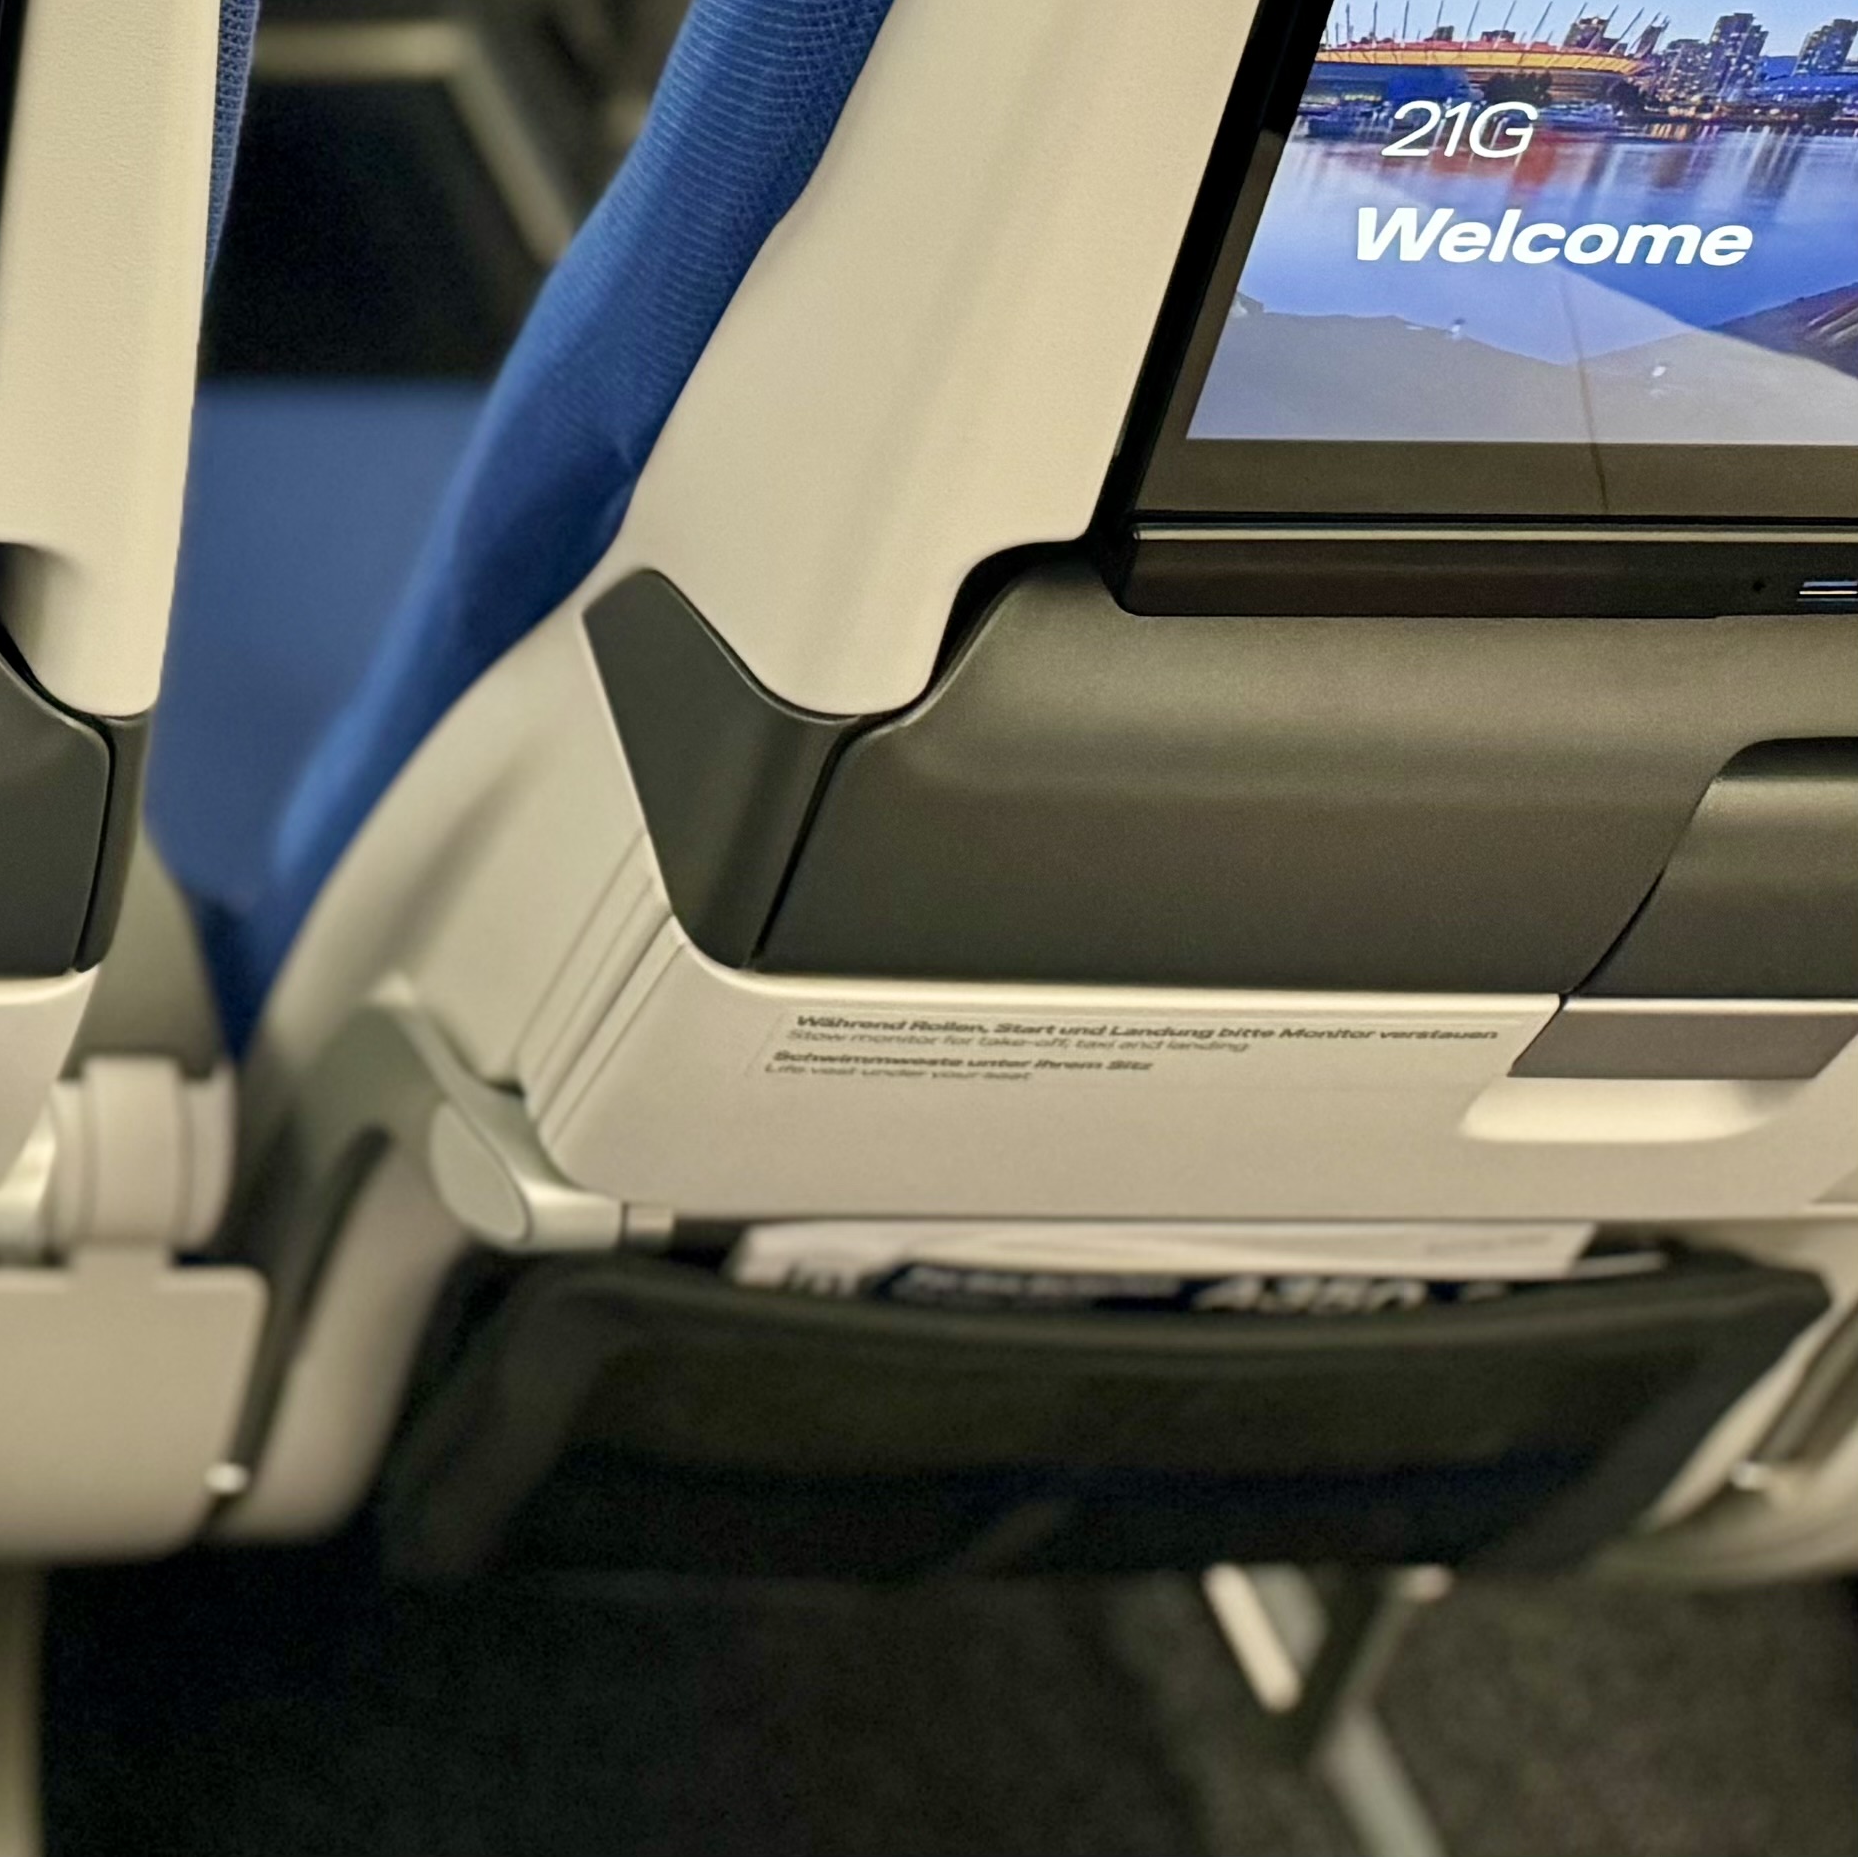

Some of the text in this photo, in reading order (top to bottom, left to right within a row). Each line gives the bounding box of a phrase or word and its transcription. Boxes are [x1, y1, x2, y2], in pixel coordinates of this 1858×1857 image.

[1381, 99, 1539, 159] 21G
[1356, 206, 1754, 266] Welcome
[796, 1015, 1499, 1040] Während Rollen, Start und Landung bitte Monitor verstauen
